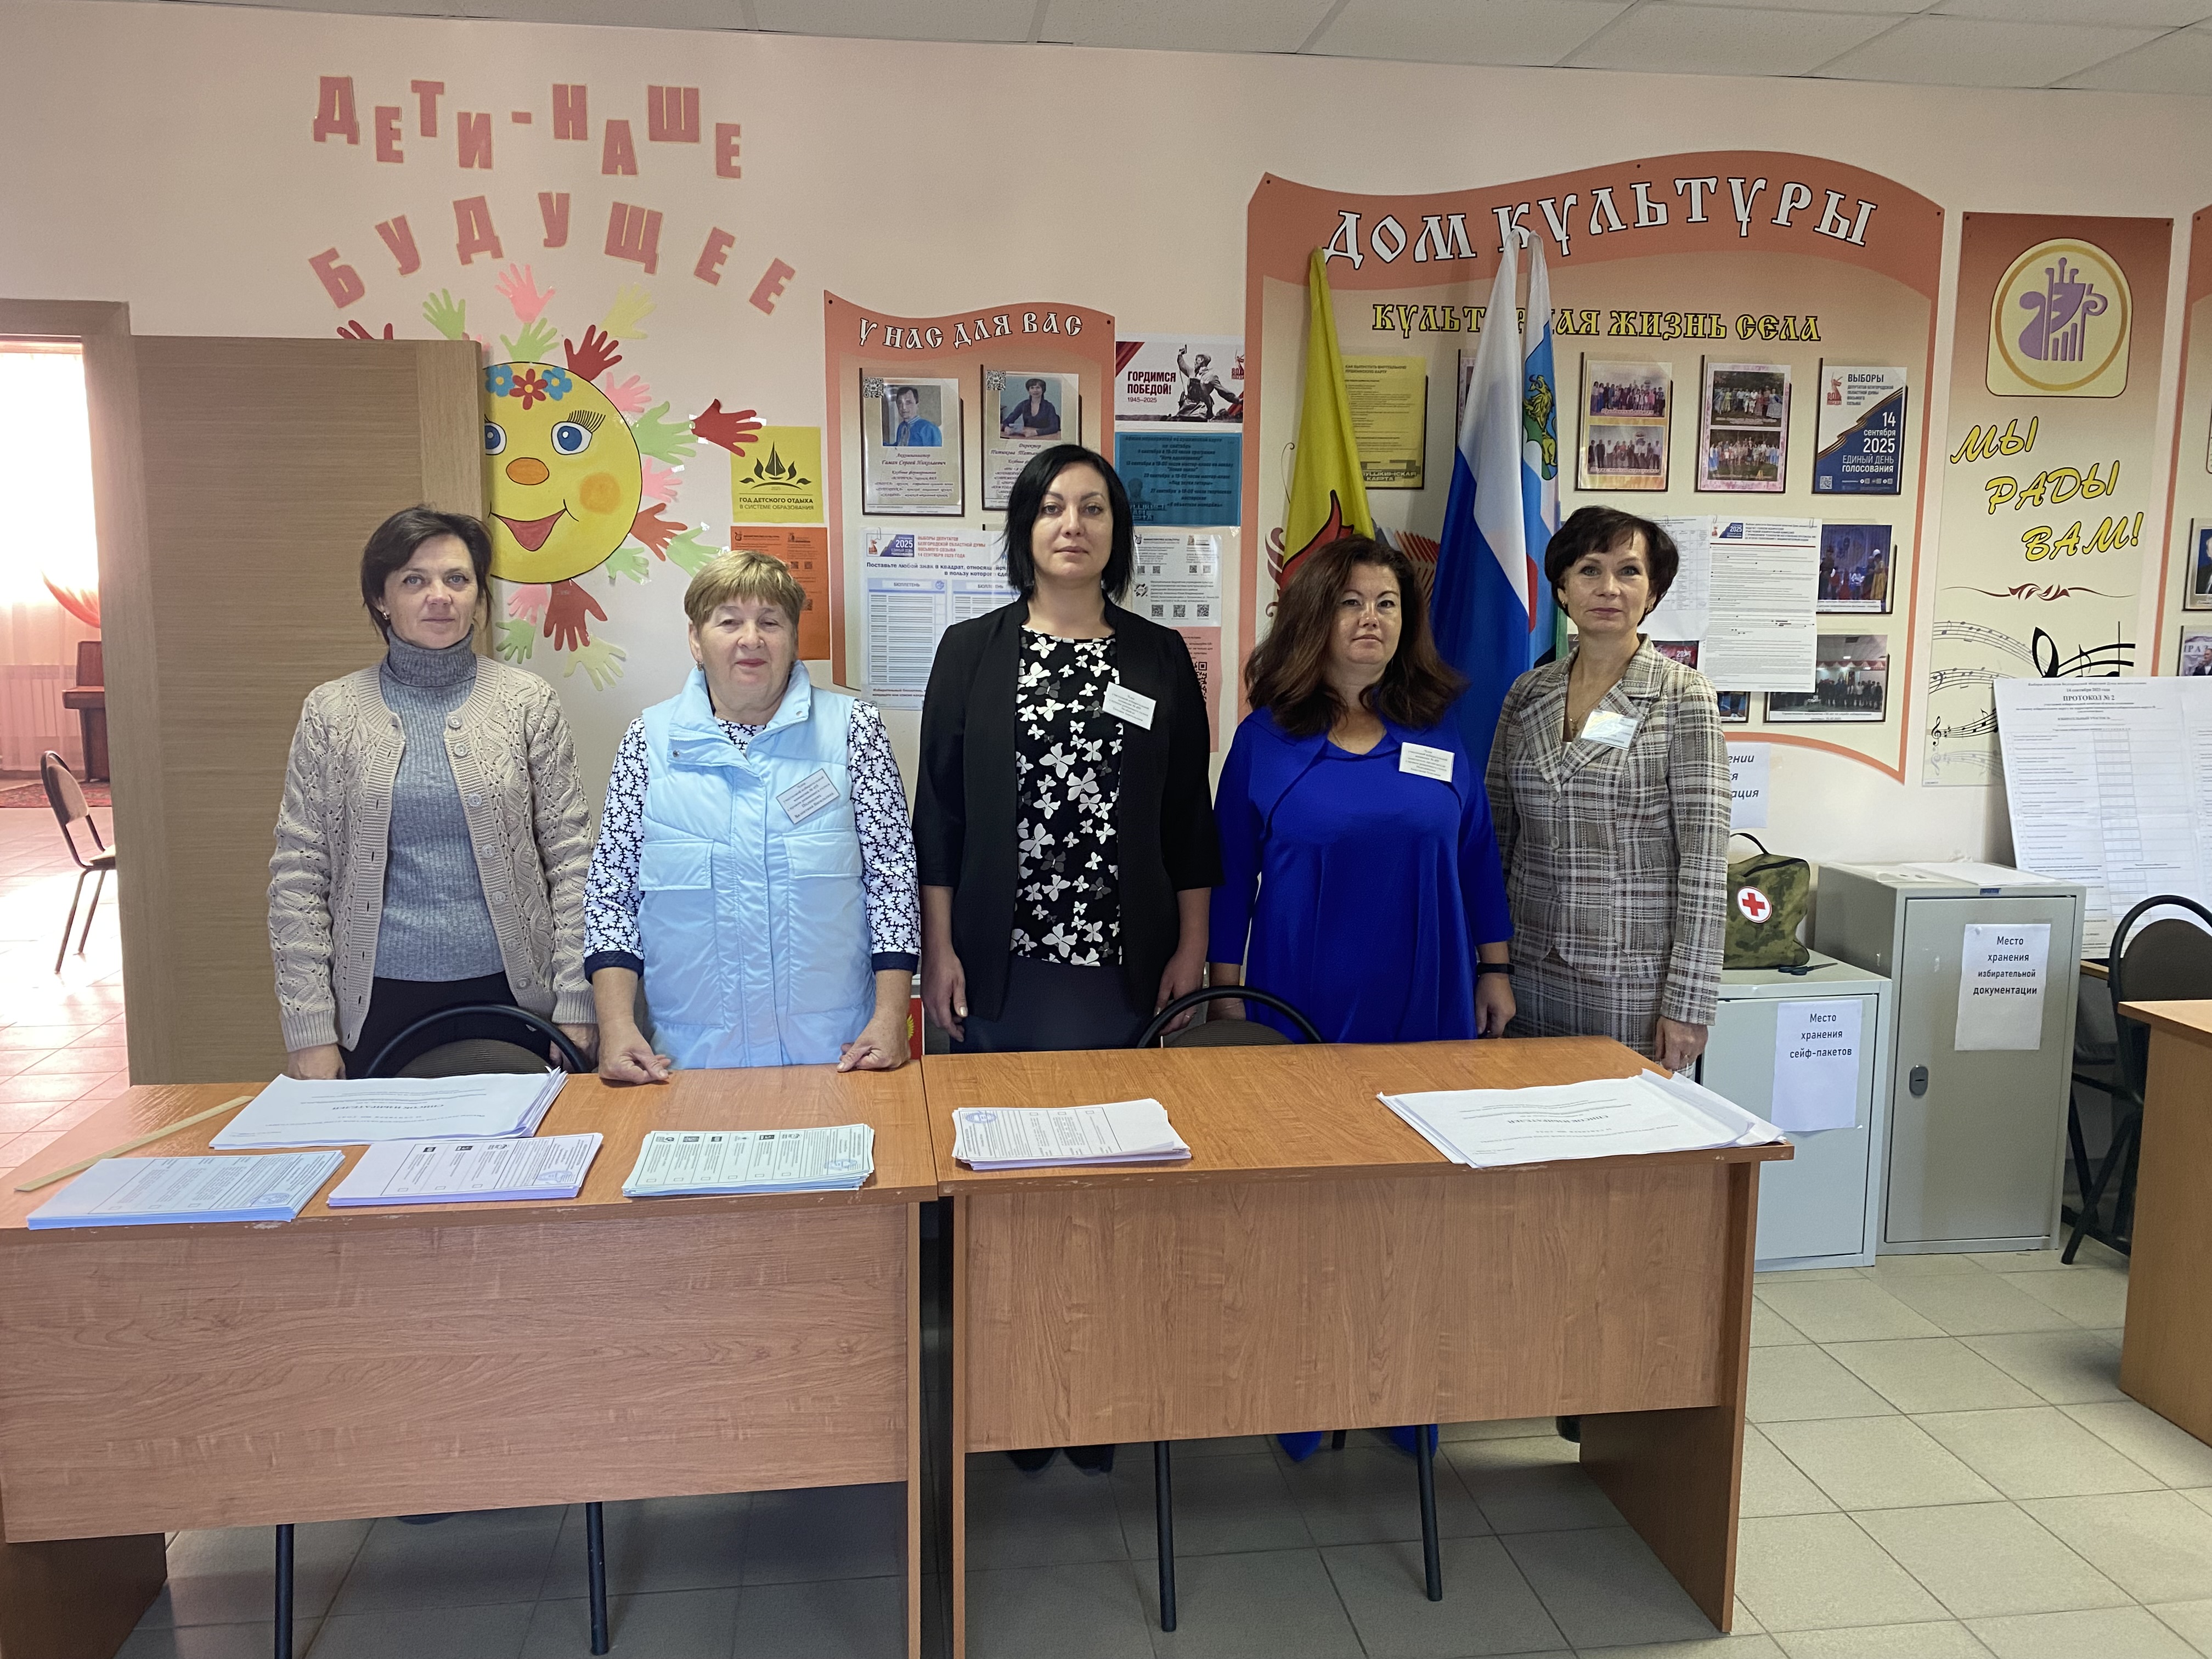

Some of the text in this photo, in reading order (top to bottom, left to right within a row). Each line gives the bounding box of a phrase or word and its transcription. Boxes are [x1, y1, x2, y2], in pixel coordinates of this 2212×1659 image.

[1322, 175, 1878, 270] ДОМ КУЛЬТУРЫ
[308, 191, 797, 317] БУДУЩЕЕ
[1372, 304, 1822, 342] КУЛЬТРАЯ ЖИЗНЬ СЕЛА
[859, 312, 1083, 349] У НАС ДЛЯ ВАС
[1127, 371, 1176, 383] ГОРДИМСЯ
[1848, 374, 1884, 382] ВЫБОРЫ
[1127, 383, 1172, 395] ПОБЕДОЙ!
[1882, 412, 1895, 427] 14
[1864, 429, 1896, 438] сентября
[1863, 438, 1895, 453] 2025
[1950, 416, 2039, 464] МЫ
[1842, 454, 1894, 465] ЕДИНЫЙ ДЕНЬ
[1984, 460, 2120, 515] РАДЫ
[2021, 511, 2145, 561] ВАМ!
[895, 540, 913, 548] 2025
[1996, 935, 2024, 946] Место
[1988, 953, 2029, 963] хранения
[1978, 968, 2036, 979] избирательной
[1973, 985, 2038, 997] документации
[1809, 1013, 1837, 1023] Место
[1801, 1029, 1843, 1041] хранения
[1790, 1047, 1853, 1060] сейф-пакетов
